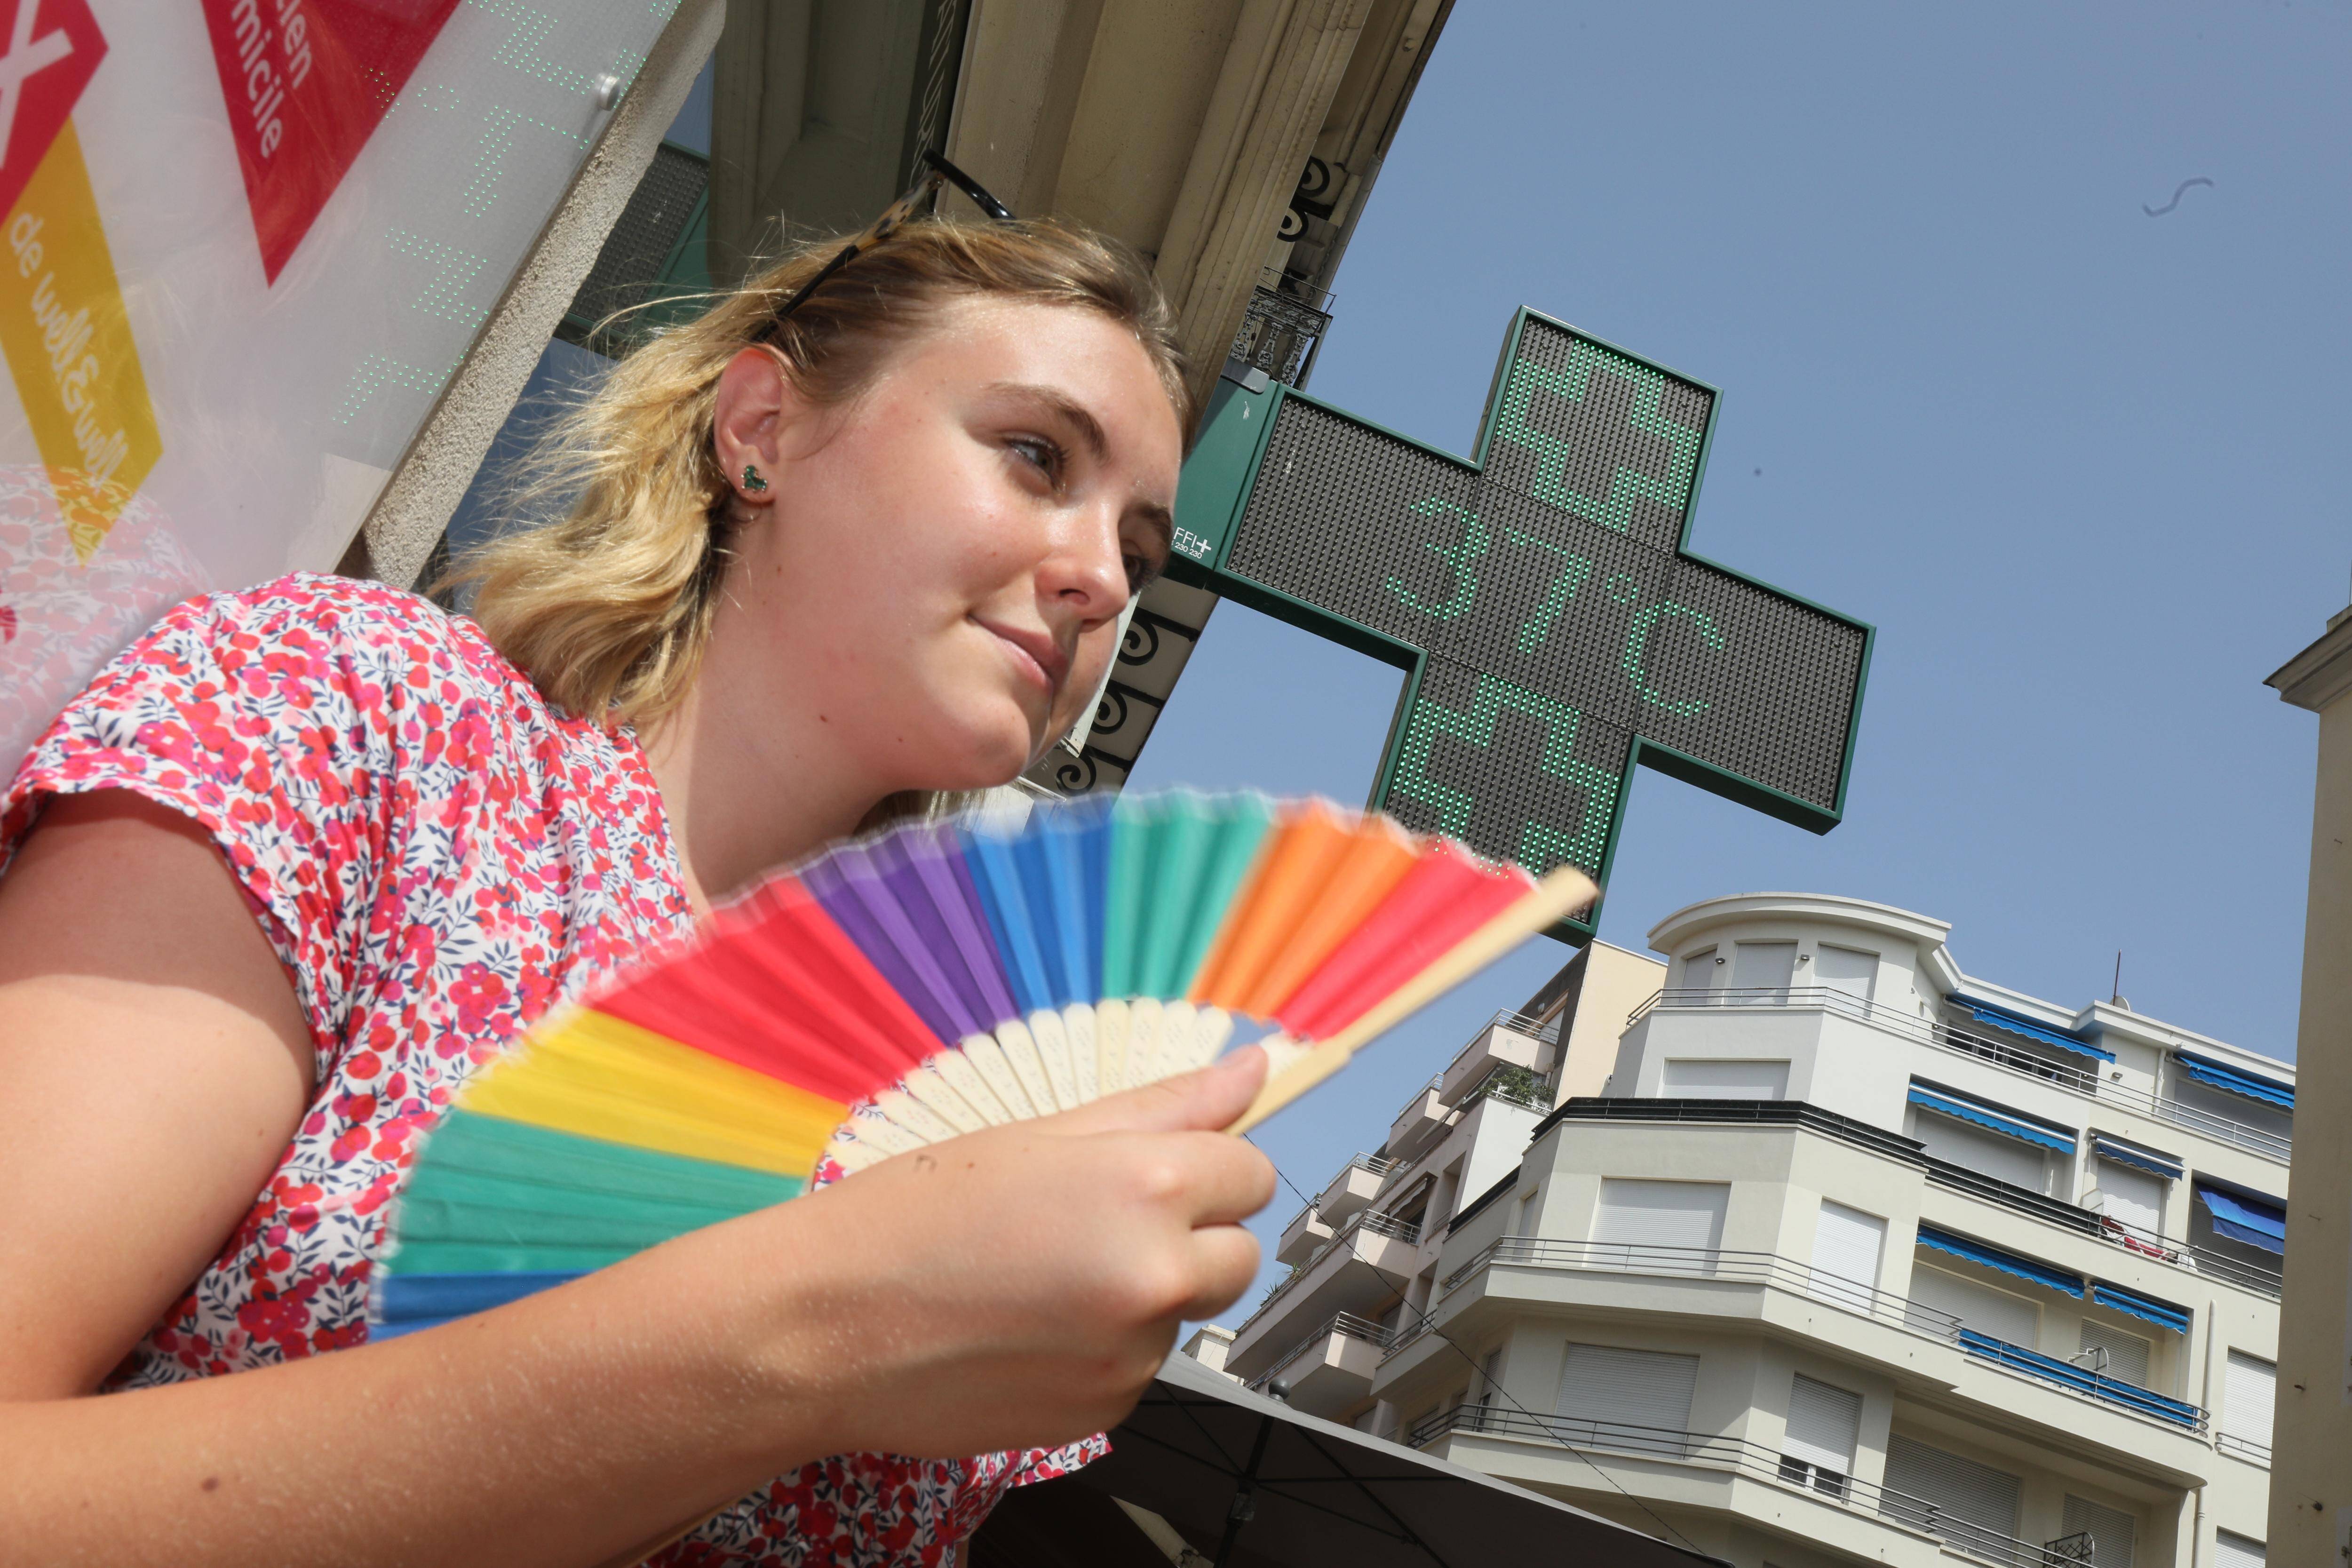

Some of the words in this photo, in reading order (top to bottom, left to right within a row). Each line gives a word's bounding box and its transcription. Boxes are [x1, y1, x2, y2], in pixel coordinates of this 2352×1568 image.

[9, 212, 44, 279] de
[1174, 542, 1189, 552] 230
[1189, 549, 1202, 559] 230
[1386, 497, 1723, 716] 37°C
